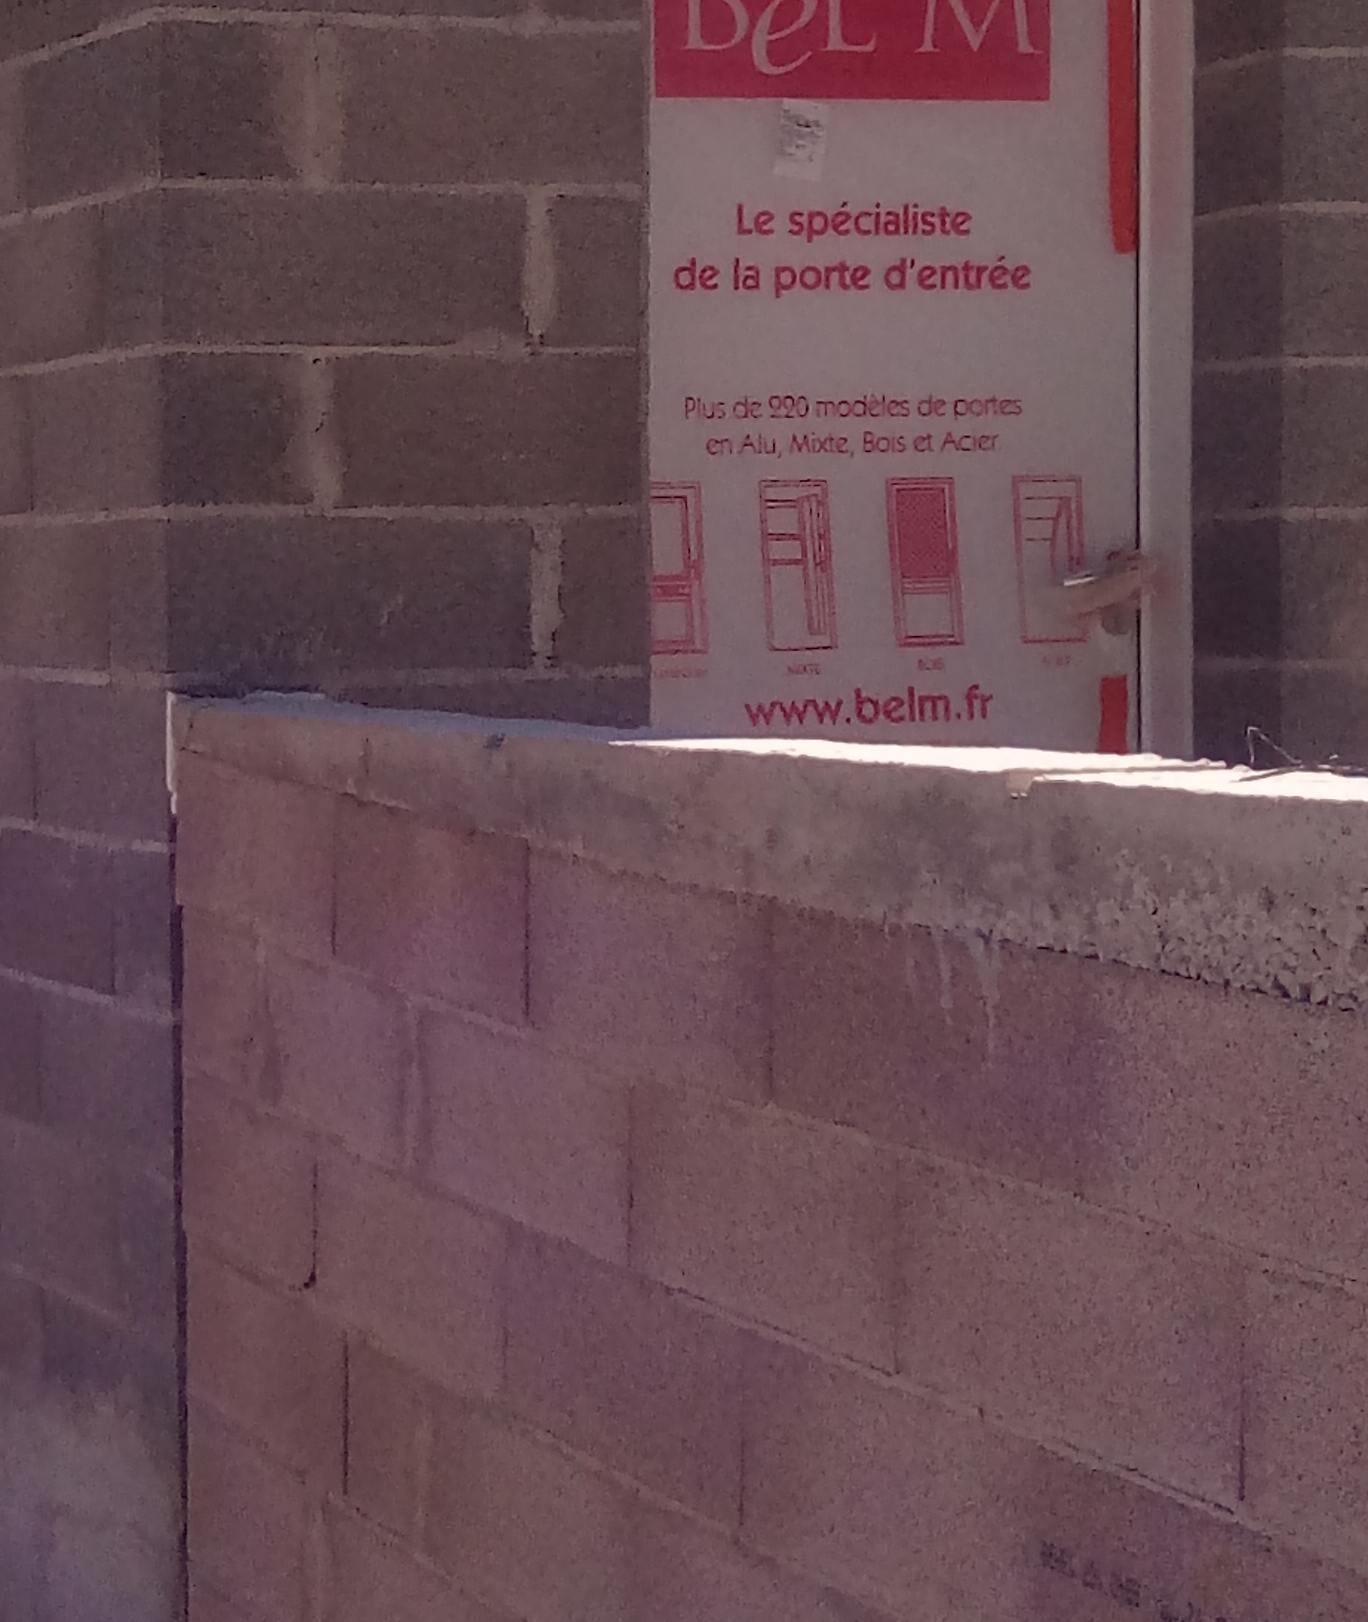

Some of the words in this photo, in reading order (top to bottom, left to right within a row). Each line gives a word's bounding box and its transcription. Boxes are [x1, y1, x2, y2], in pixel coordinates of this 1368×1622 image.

[736, 203, 775, 236] Le
[788, 201, 973, 243] spécialiste
[673, 257, 720, 291] de
[733, 257, 761, 291] la
[774, 260, 872, 298] porte
[884, 255, 1032, 291] d'entrée
[685, 396, 726, 420] Plus
[733, 396, 763, 419] de
[768, 395, 809, 419] 220
[816, 394, 911, 418] modèles
[917, 394, 946, 417] de
[954, 395, 1023, 420] portes
[706, 437, 733, 455] en
[739, 433, 782, 459] Alu,
[790, 432, 854, 459] Mixte,
[863, 431, 907, 453] Bois
[913, 433, 934, 453] et
[941, 431, 999, 452] Acier
[744, 684, 994, 727] www.belm.fr
